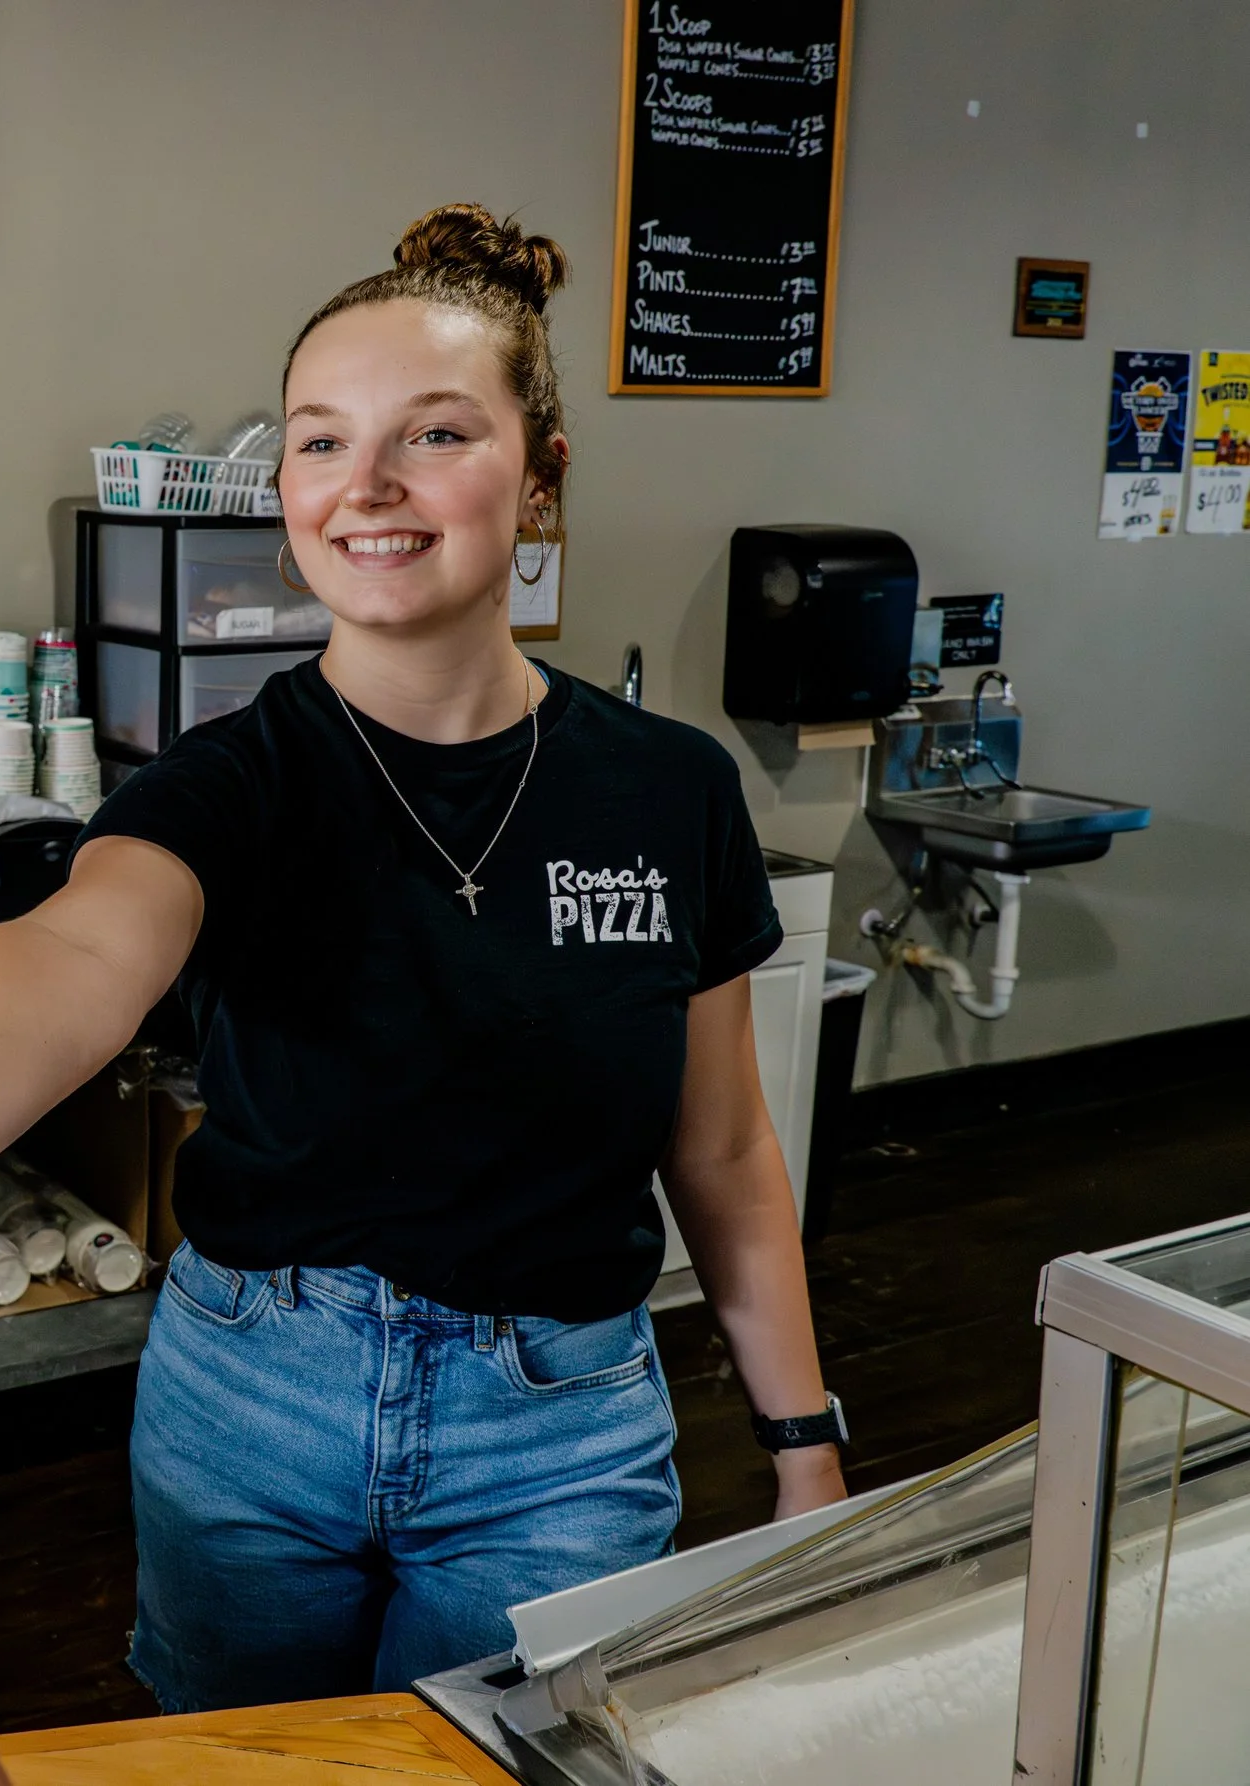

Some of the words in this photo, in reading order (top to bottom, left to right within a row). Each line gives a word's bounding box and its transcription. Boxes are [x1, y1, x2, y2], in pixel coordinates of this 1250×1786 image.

[648, 0, 664, 33] 1
[666, 4, 711, 36] SCOOP
[643, 72, 658, 107] 2
[660, 77, 713, 115] SCOOPS
[639, 219, 693, 256] JUNIOR
[636, 260, 686, 294] PINTS
[630, 298, 691, 336] SHAKES
[629, 345, 687, 377] MALTS
[1201, 381, 1248, 407] TWISTED
[546, 855, 669, 895] Rosa's
[550, 891, 673, 946] PIZZA
